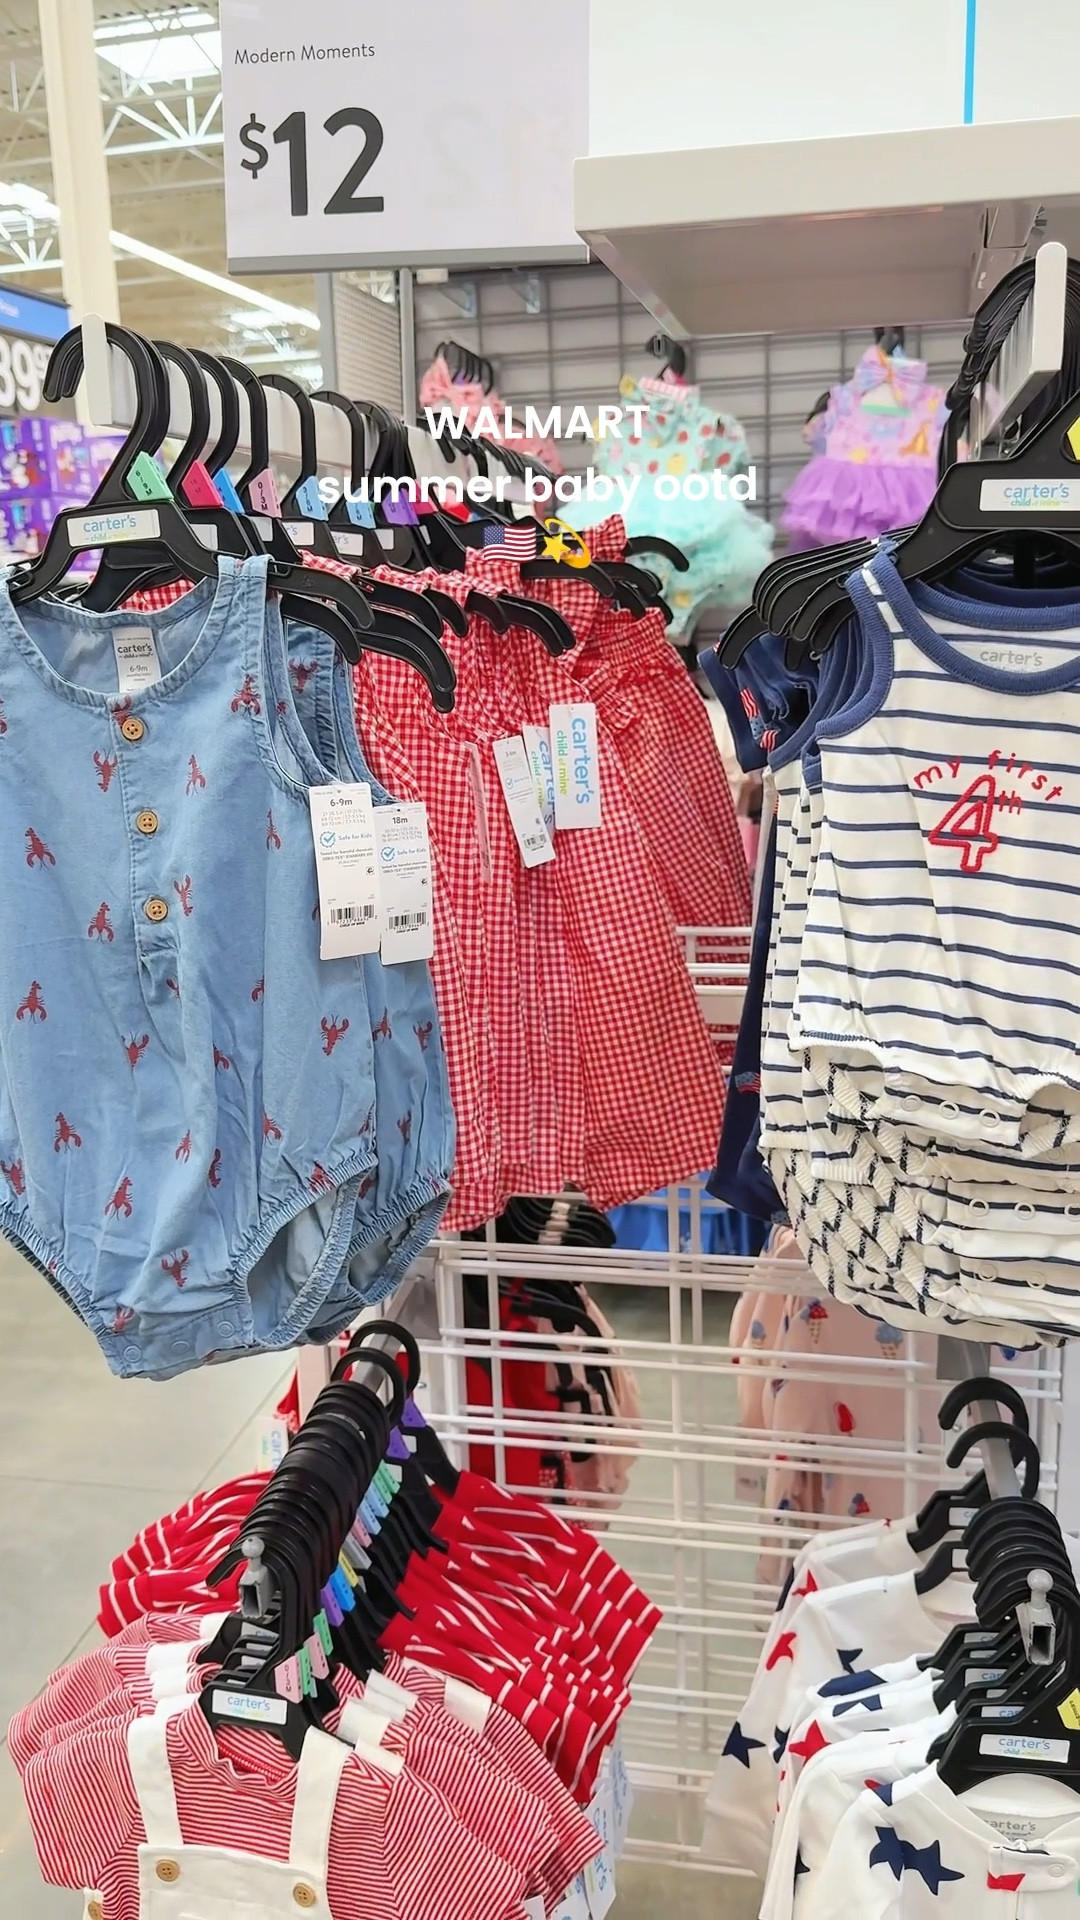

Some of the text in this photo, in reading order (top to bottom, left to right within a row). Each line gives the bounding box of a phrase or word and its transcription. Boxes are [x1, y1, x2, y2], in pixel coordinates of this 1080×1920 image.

[234, 43, 376, 65] Modern Moments
[239, 107, 385, 217] $12
[1003, 482, 1070, 499] carter's
[1010, 498, 1031, 507] child
[83, 514, 137, 533] carter's
[117, 643, 153, 654] carter's
[980, 650, 1044, 667] carter's
[129, 664, 149, 673] 6-9m
[556, 730, 568, 757] child
[530, 751, 542, 777] child
[571, 717, 595, 804] carter's
[558, 768, 570, 796] mine
[913, 749, 1063, 801] my first
[330, 798, 353, 807] 6-9m
[392, 816, 409, 825] 18m
[227, 1695, 271, 1712] carter's
[998, 1737, 1051, 1750] carter's
[984, 1820, 1036, 1831] arter's
